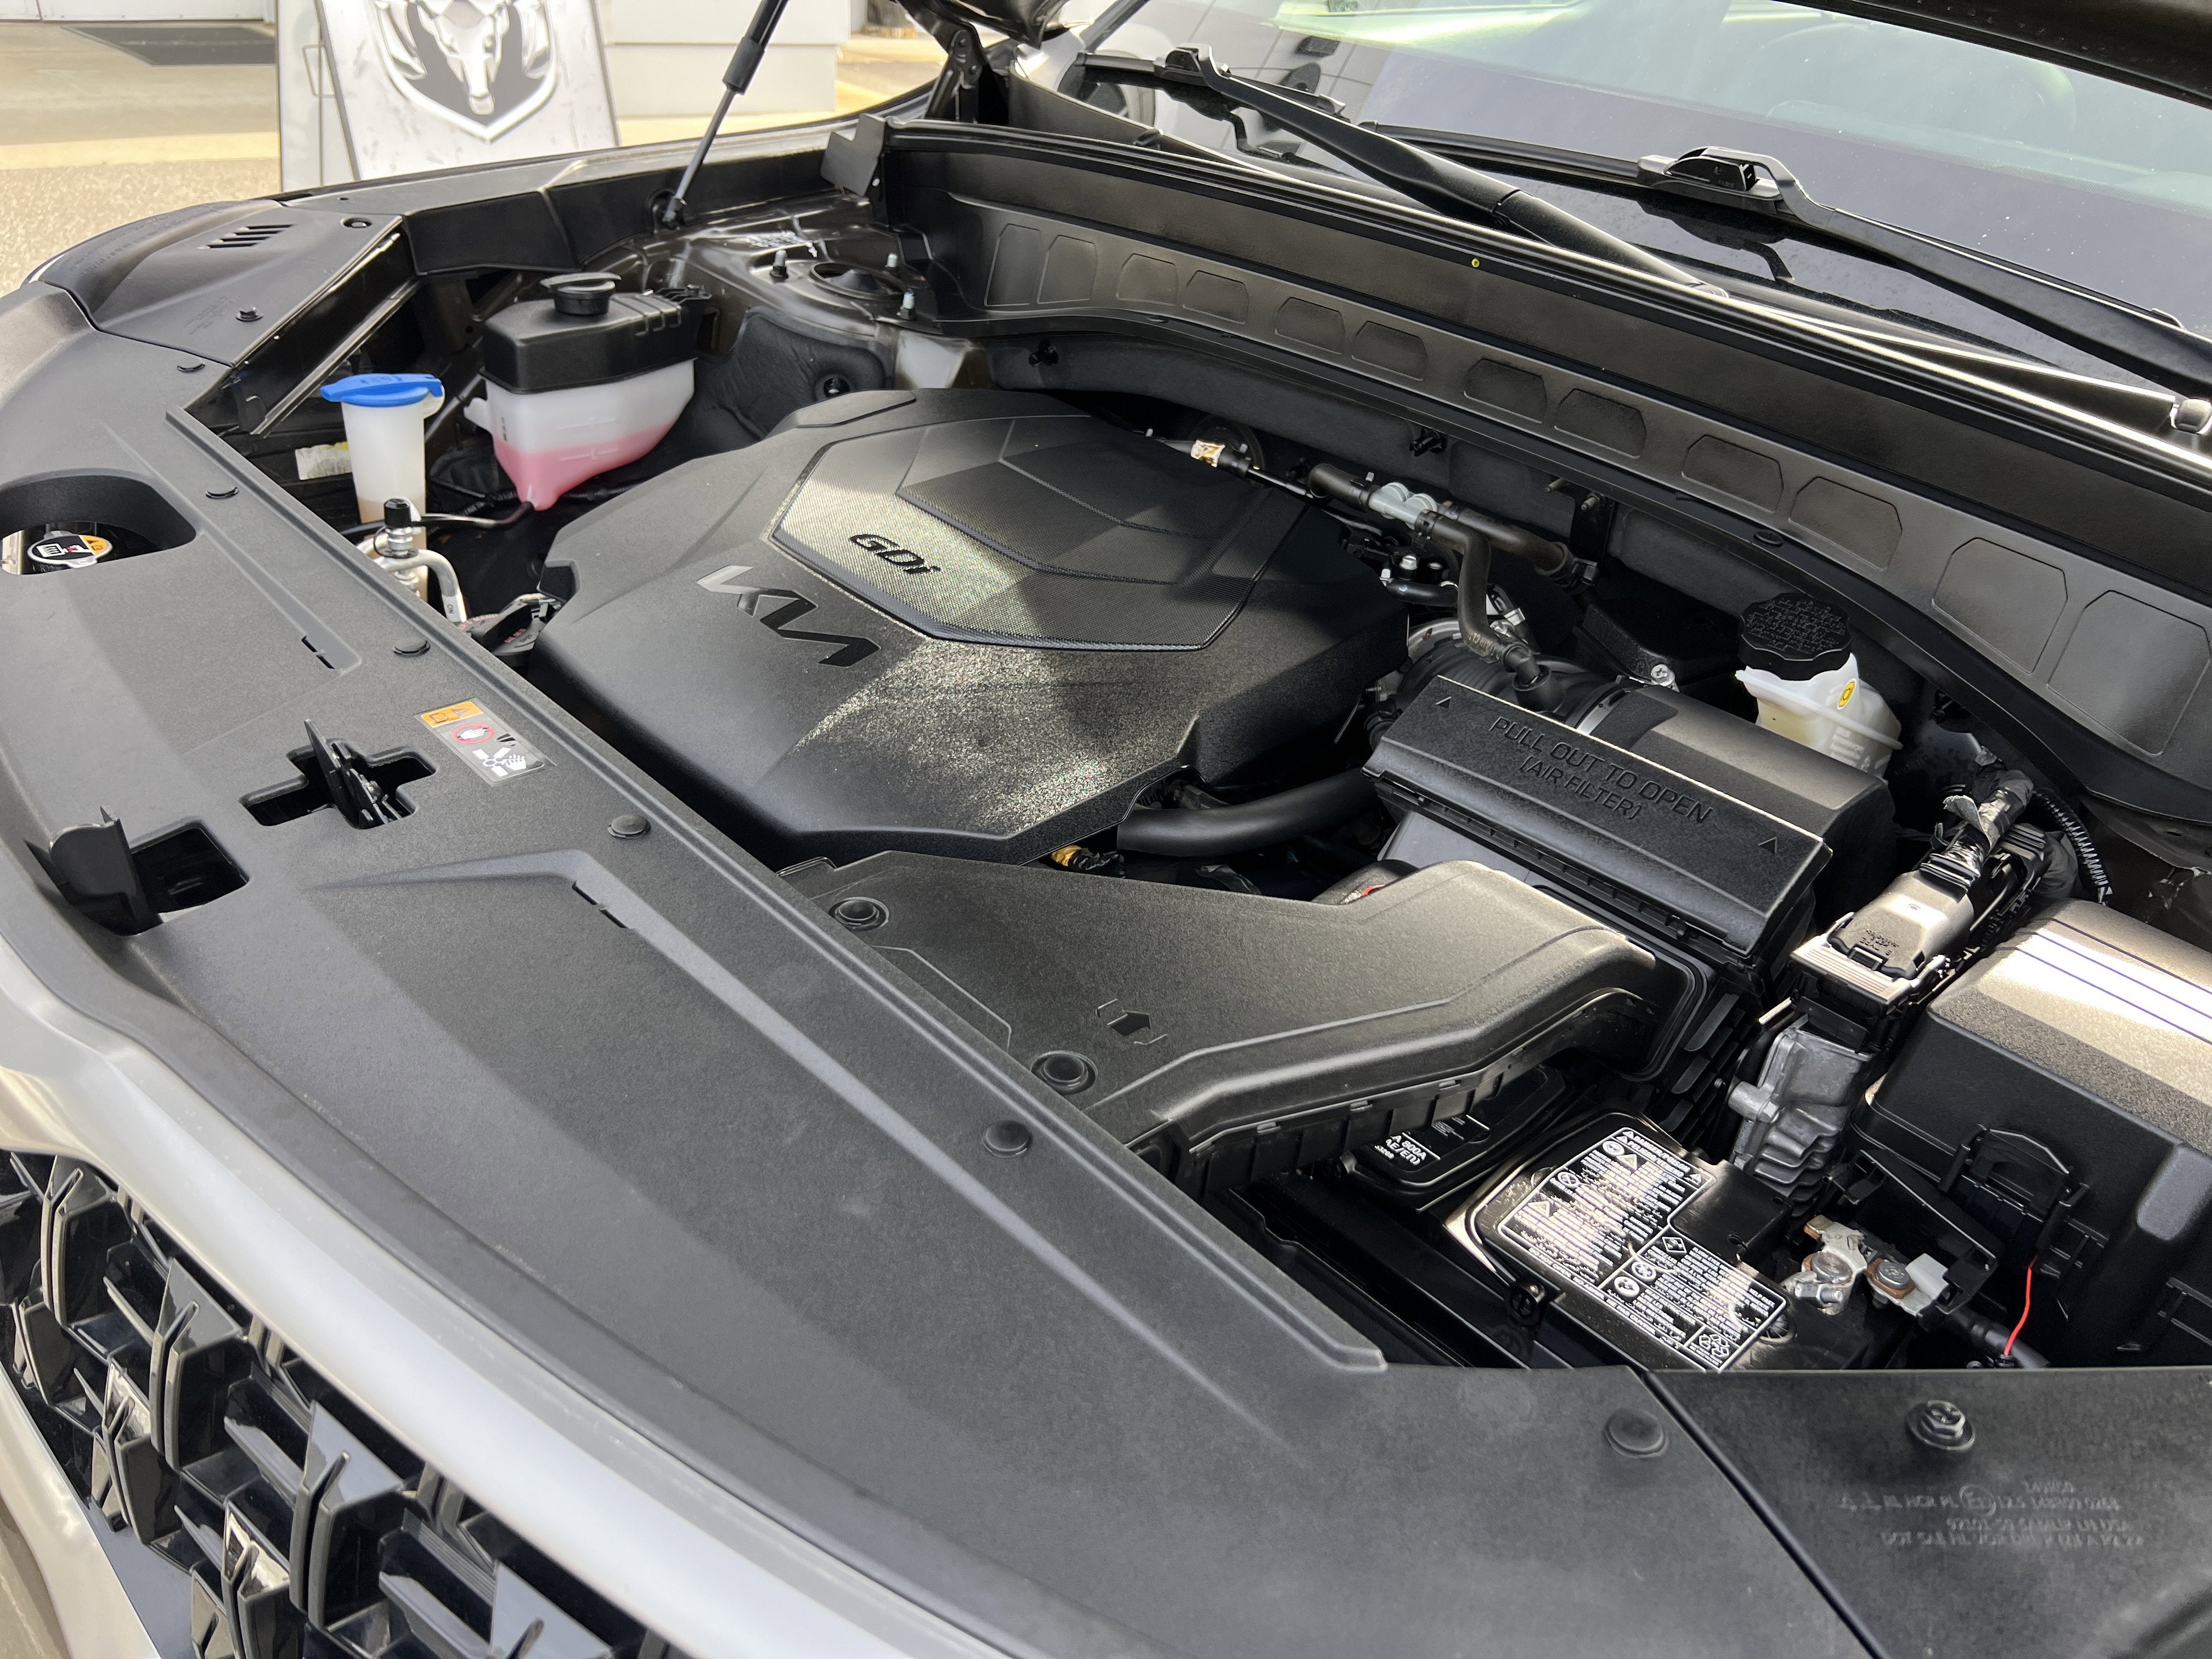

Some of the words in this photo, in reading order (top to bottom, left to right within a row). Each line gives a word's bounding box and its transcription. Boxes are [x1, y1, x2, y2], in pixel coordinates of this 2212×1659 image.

[849, 534, 941, 574] GDi
[1488, 716, 1545, 752] PULL
[1550, 742, 1605, 773] OUT
[1604, 763, 1639, 790] TO
[1639, 780, 1714, 823] OPEN
[1401, 1140, 1427, 1161] 800A
[1626, 1141, 1684, 1178] PELIGRO/VENENO
[1632, 1136, 1690, 1173] DANGER/POISON
